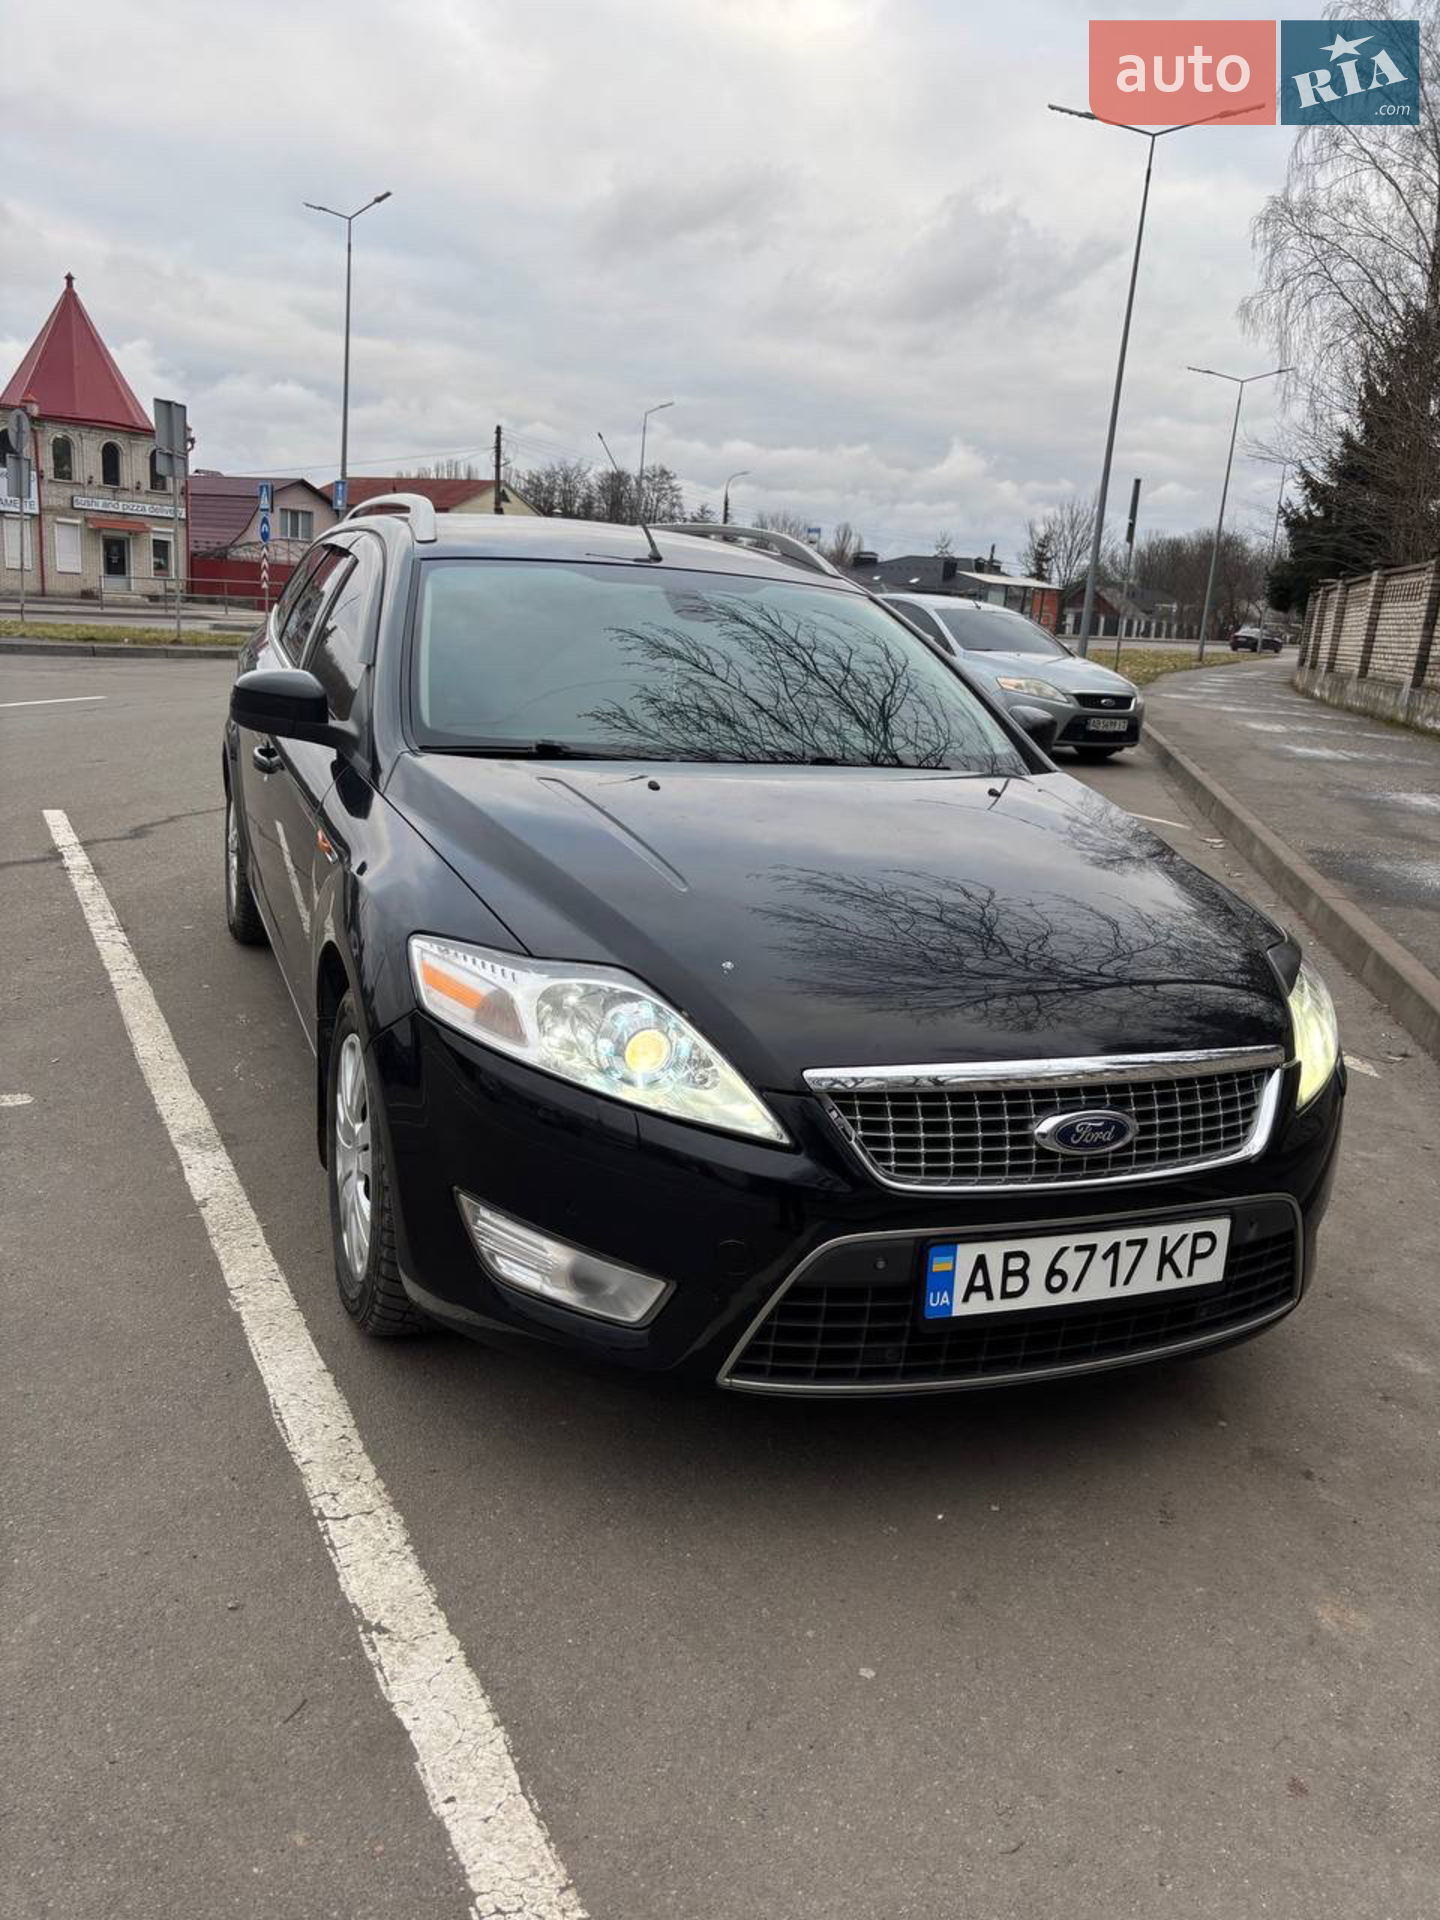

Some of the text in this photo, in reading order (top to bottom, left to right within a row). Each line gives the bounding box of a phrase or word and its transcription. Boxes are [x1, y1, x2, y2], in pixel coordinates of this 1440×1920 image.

[101, 500, 119, 510] and
[122, 503, 146, 513] pizza
[1070, 1121, 1115, 1144] Ford
[961, 1230, 1218, 1303] AB 6717 KP
[929, 1290, 950, 1307] UA
